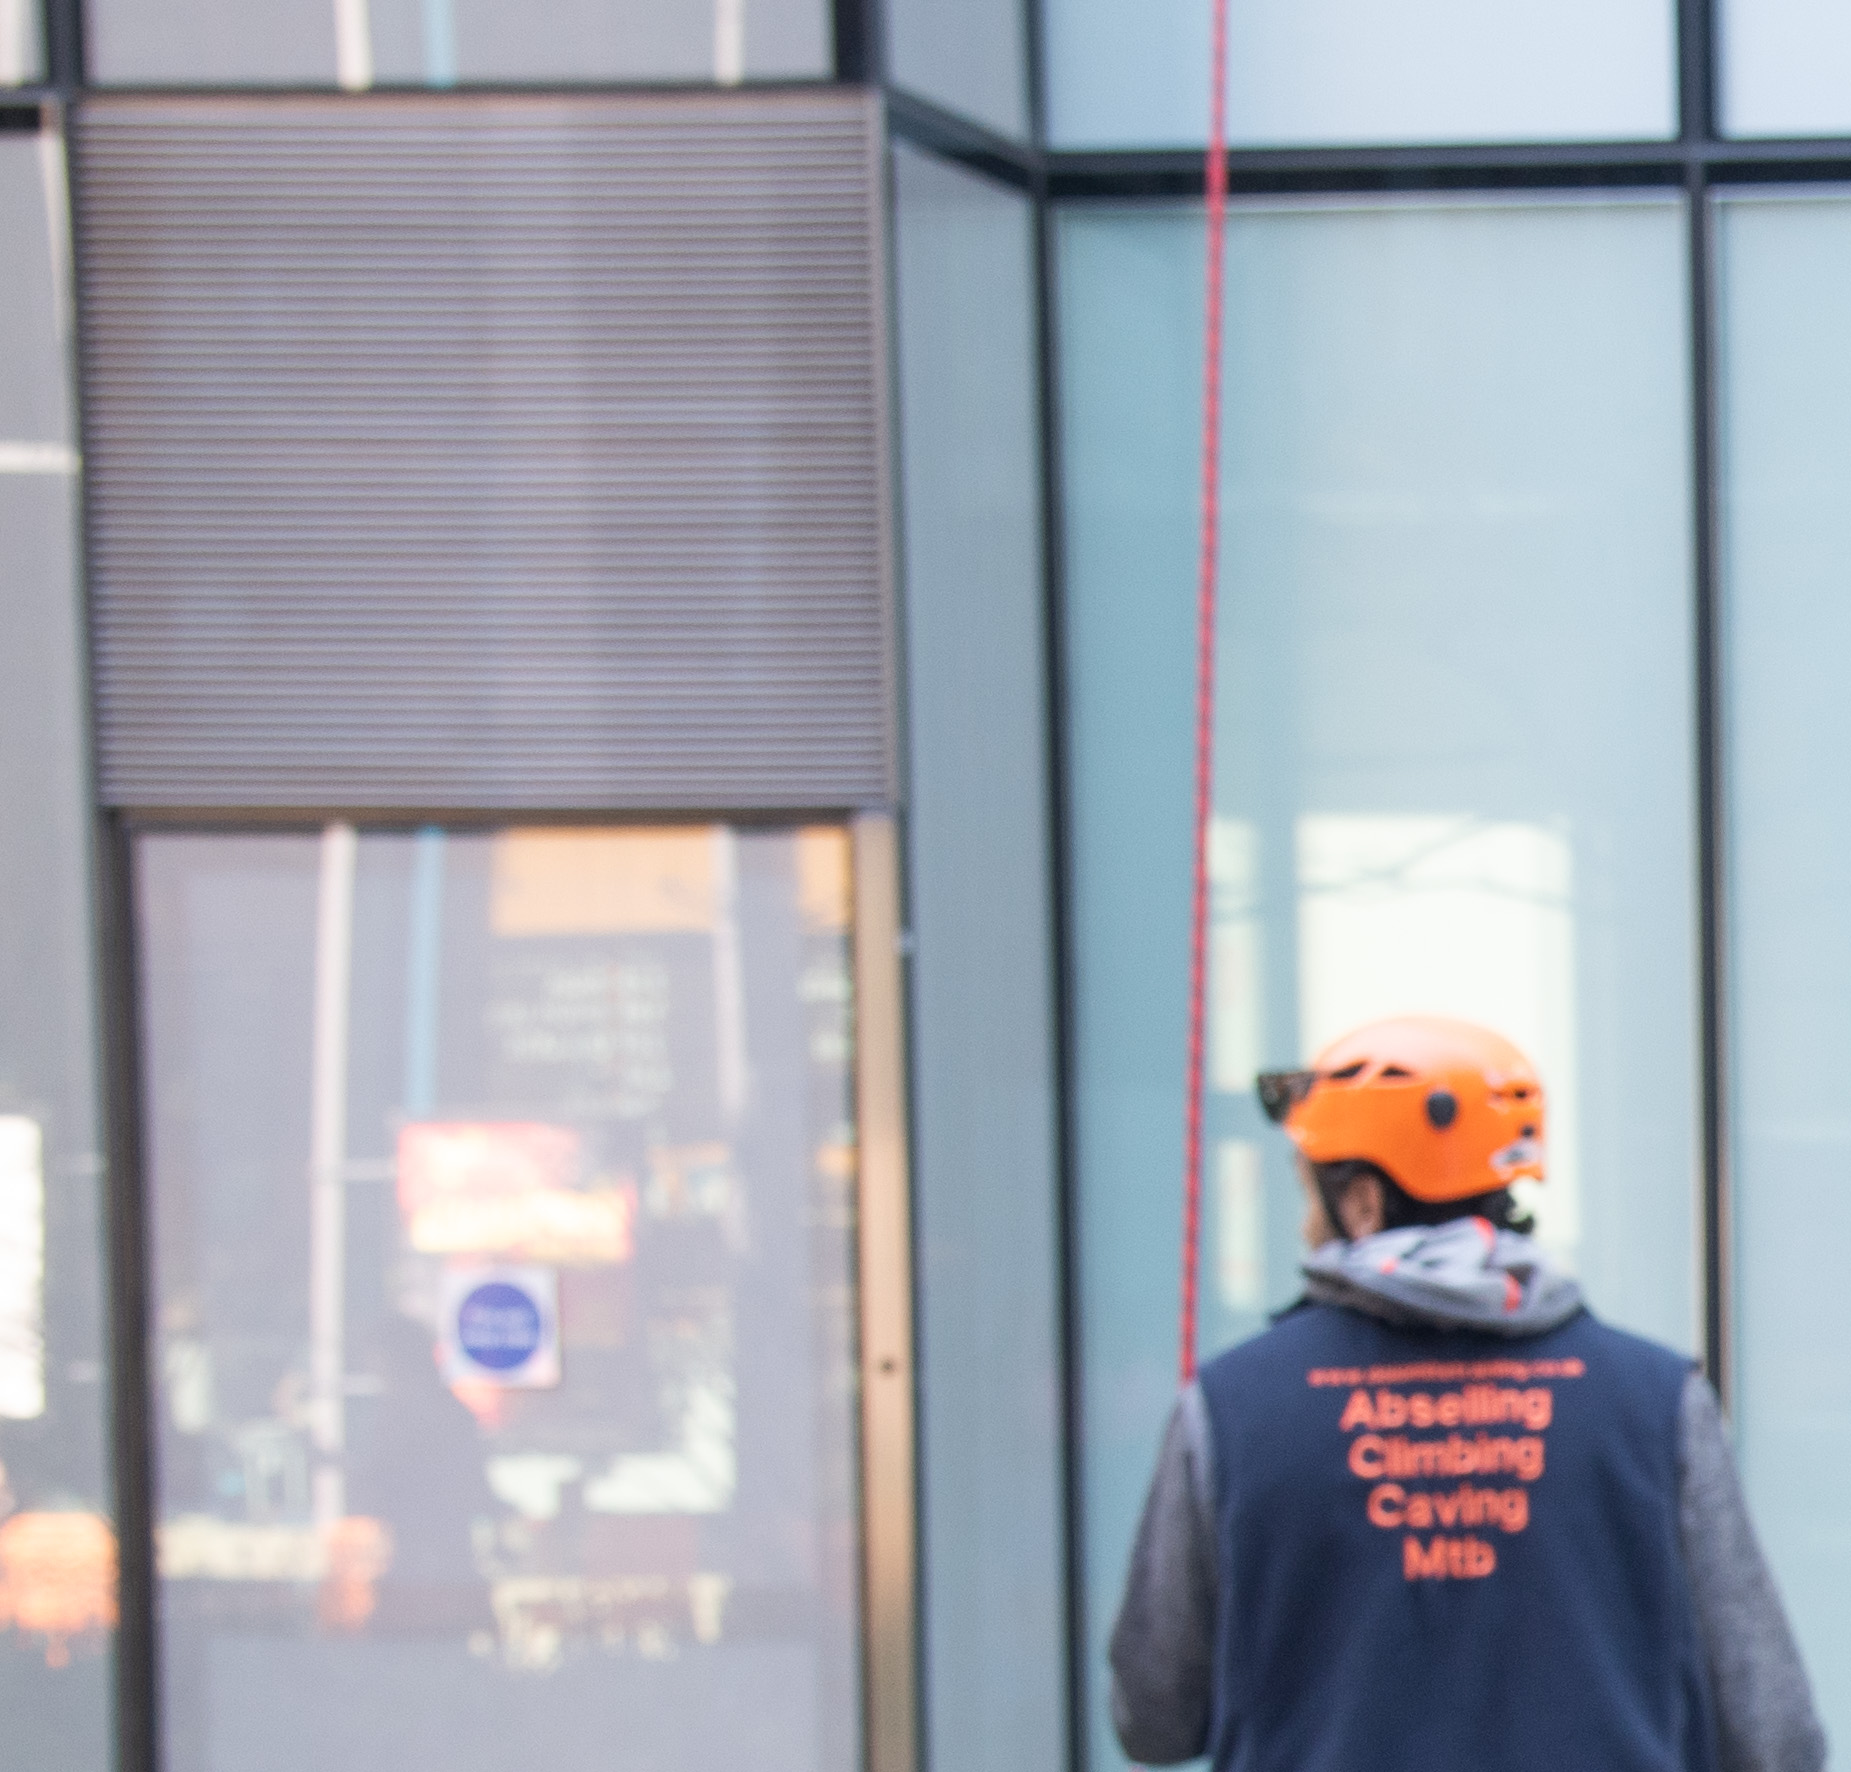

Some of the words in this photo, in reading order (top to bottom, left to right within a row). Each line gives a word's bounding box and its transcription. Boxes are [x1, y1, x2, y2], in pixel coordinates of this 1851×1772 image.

[1338, 1386, 1554, 1434] Abseiling
[1346, 1431, 1546, 1481] Climbing
[1366, 1482, 1529, 1534] Caving
